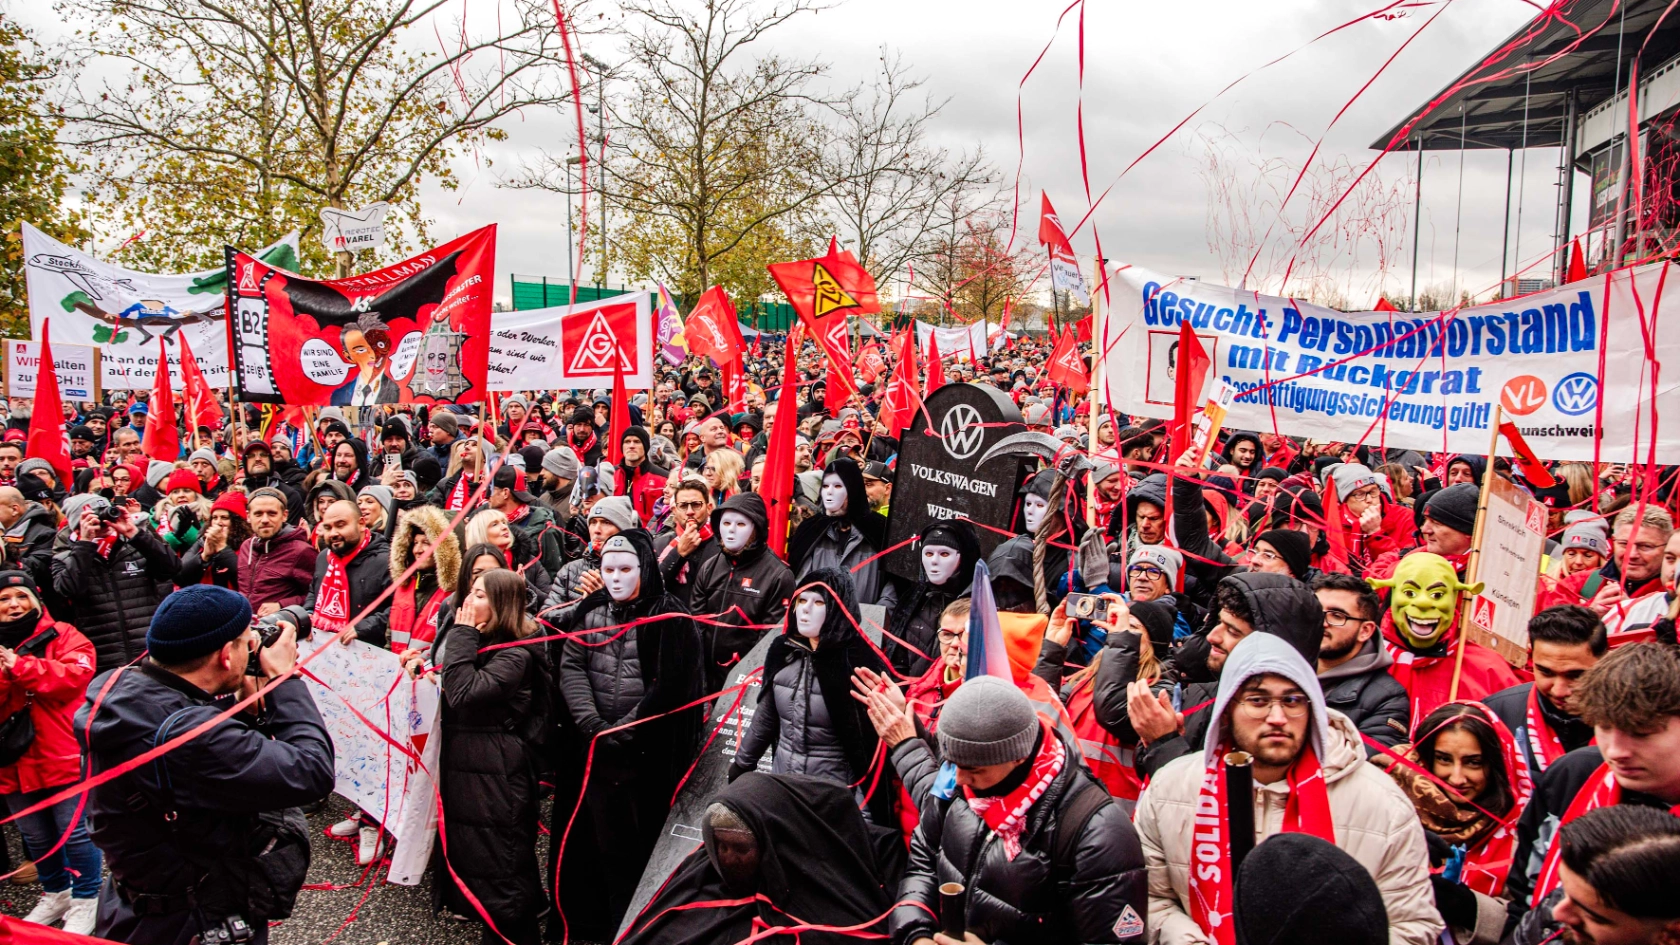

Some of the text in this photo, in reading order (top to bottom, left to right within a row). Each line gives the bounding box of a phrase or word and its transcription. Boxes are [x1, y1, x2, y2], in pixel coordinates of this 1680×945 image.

[346, 234, 375, 244] VAREL
[242, 310, 260, 335] B2
[1143, 281, 1596, 359] Gesucht: Personalvorstand
[497, 330, 558, 348] oder Werker,
[303, 348, 334, 357] WIR SIND
[506, 350, 526, 360] sind
[530, 354, 547, 363] wir
[53, 360, 86, 371] alten
[246, 363, 265, 379] zeigt
[312, 360, 331, 368] EINE
[487, 364, 518, 375] ärker!
[1228, 344, 1483, 396] mit Rückgrat
[18, 374, 32, 382] zu
[109, 368, 131, 376] auf
[310, 368, 344, 378] FAMILIE
[1449, 402, 1492, 432] gilt!
[1517, 424, 1604, 440] unschweig
[910, 463, 998, 498] VOLKSWAGEN
[1491, 588, 1520, 610] Kündigen
